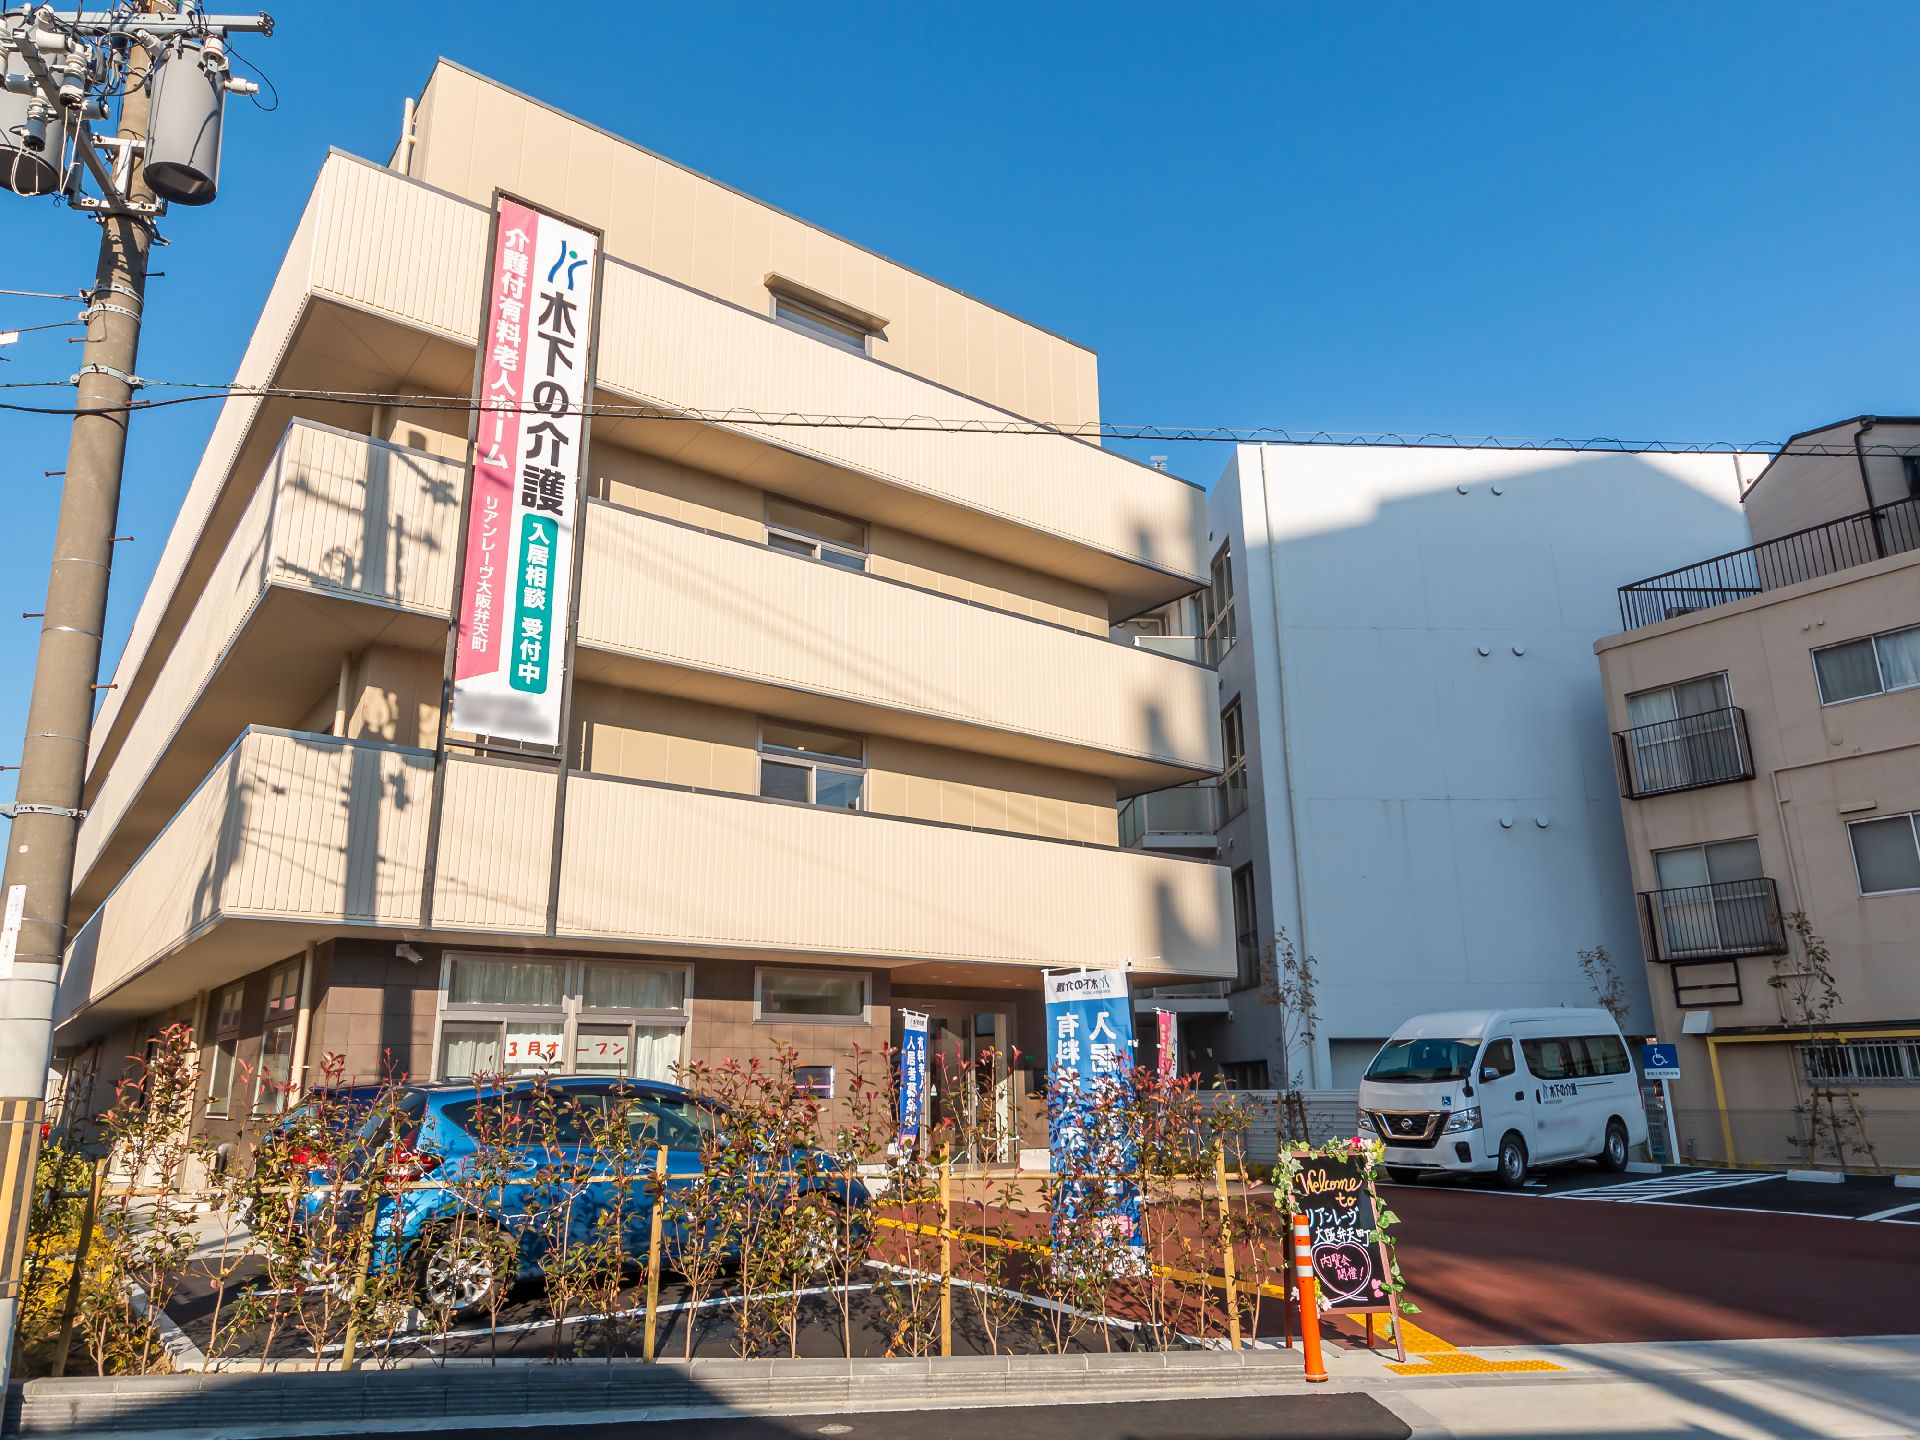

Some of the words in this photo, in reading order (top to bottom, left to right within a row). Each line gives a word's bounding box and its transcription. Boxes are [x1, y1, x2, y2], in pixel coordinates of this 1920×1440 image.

[483, 227, 531, 470] 介護付有料老人ホーム
[521, 290, 577, 517] 木下の介護
[471, 495, 500, 653] リアンレーヴ大阪弁天町
[523, 522, 550, 611] 入居相談
[517, 616, 544, 685] 受付中
[1295, 1168, 1362, 1195] Welcome
[1335, 1191, 1357, 1208] to
[1304, 1207, 1360, 1229] リアンレーヴ
[1314, 1226, 1371, 1248] 大阪弁天町
[1320, 1253, 1352, 1270] 内覧会
